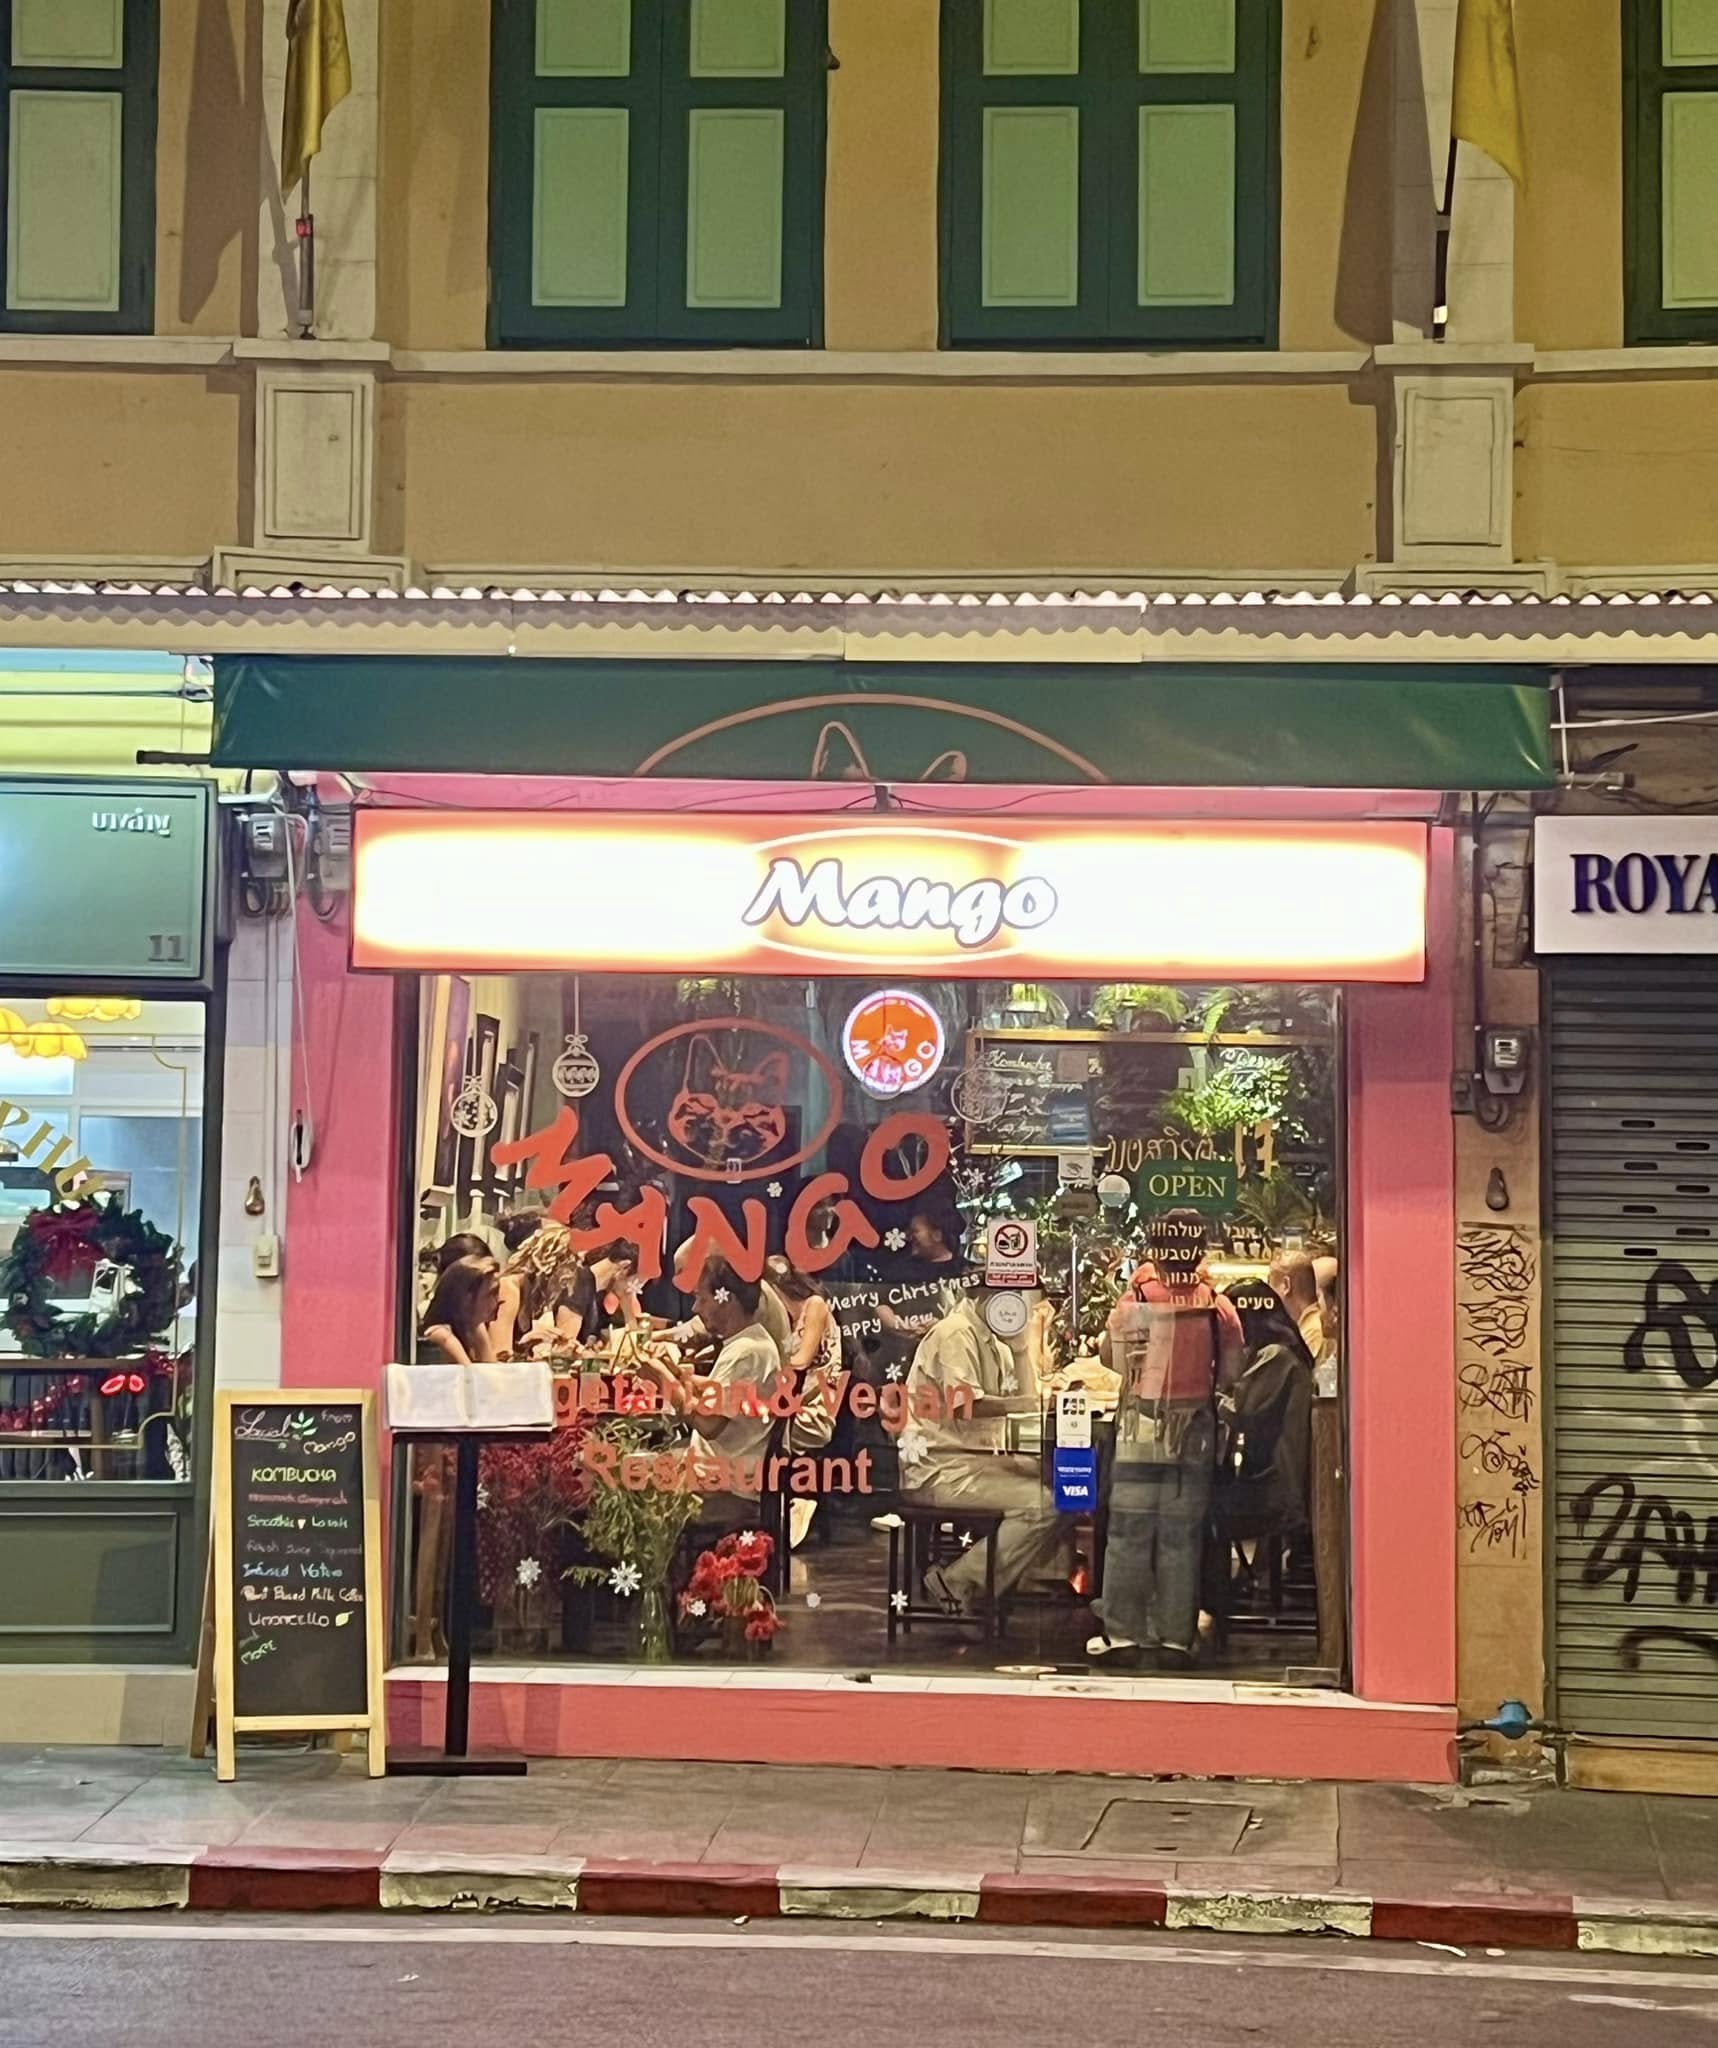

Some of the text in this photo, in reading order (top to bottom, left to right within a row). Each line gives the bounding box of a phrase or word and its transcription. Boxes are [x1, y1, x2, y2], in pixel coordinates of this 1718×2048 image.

[741, 857, 1058, 949] Mango
[149, 935, 185, 962] 11
[491, 1106, 950, 1293] MANGO
[1149, 1174, 1227, 1198] OPEN
[888, 1272, 981, 1305] Christmas
[841, 1311, 935, 1339] appy New
[553, 1369, 976, 1433] getarian & Vegan
[580, 1446, 873, 1495] Restaurant
[1062, 1485, 1088, 1497] VISA
